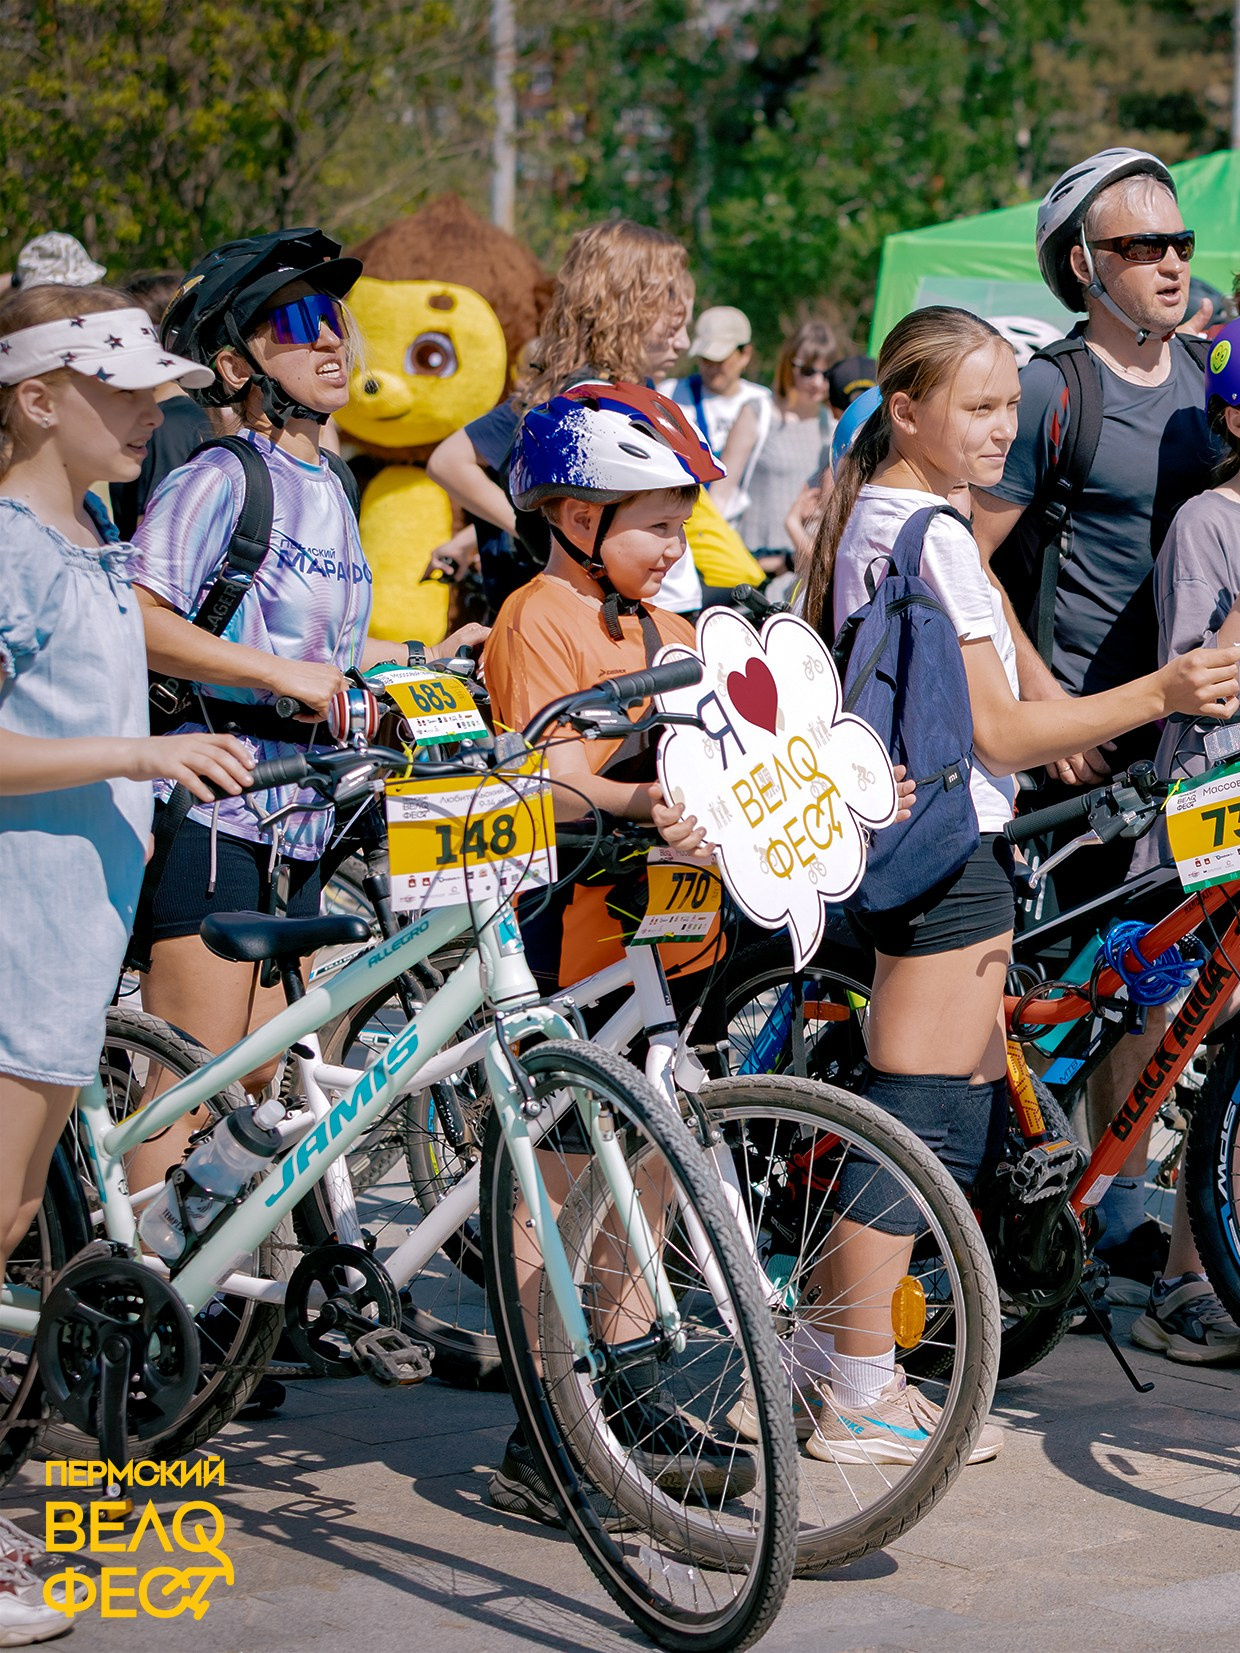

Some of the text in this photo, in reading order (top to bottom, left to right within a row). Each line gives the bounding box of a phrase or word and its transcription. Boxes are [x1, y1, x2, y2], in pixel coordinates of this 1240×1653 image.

[408, 681, 457, 712] 683
[696, 690, 747, 771] Я
[731, 736, 838, 828] ВЕЛО
[435, 814, 516, 865] 148
[766, 785, 844, 880] ФЕСТ
[665, 872, 711, 909] 770
[367, 920, 430, 968] ALLEGRO
[264, 1023, 419, 1208] JAMIS
[1111, 1042, 1180, 1142] BLACK
[836, 1415, 865, 1435] NIKE
